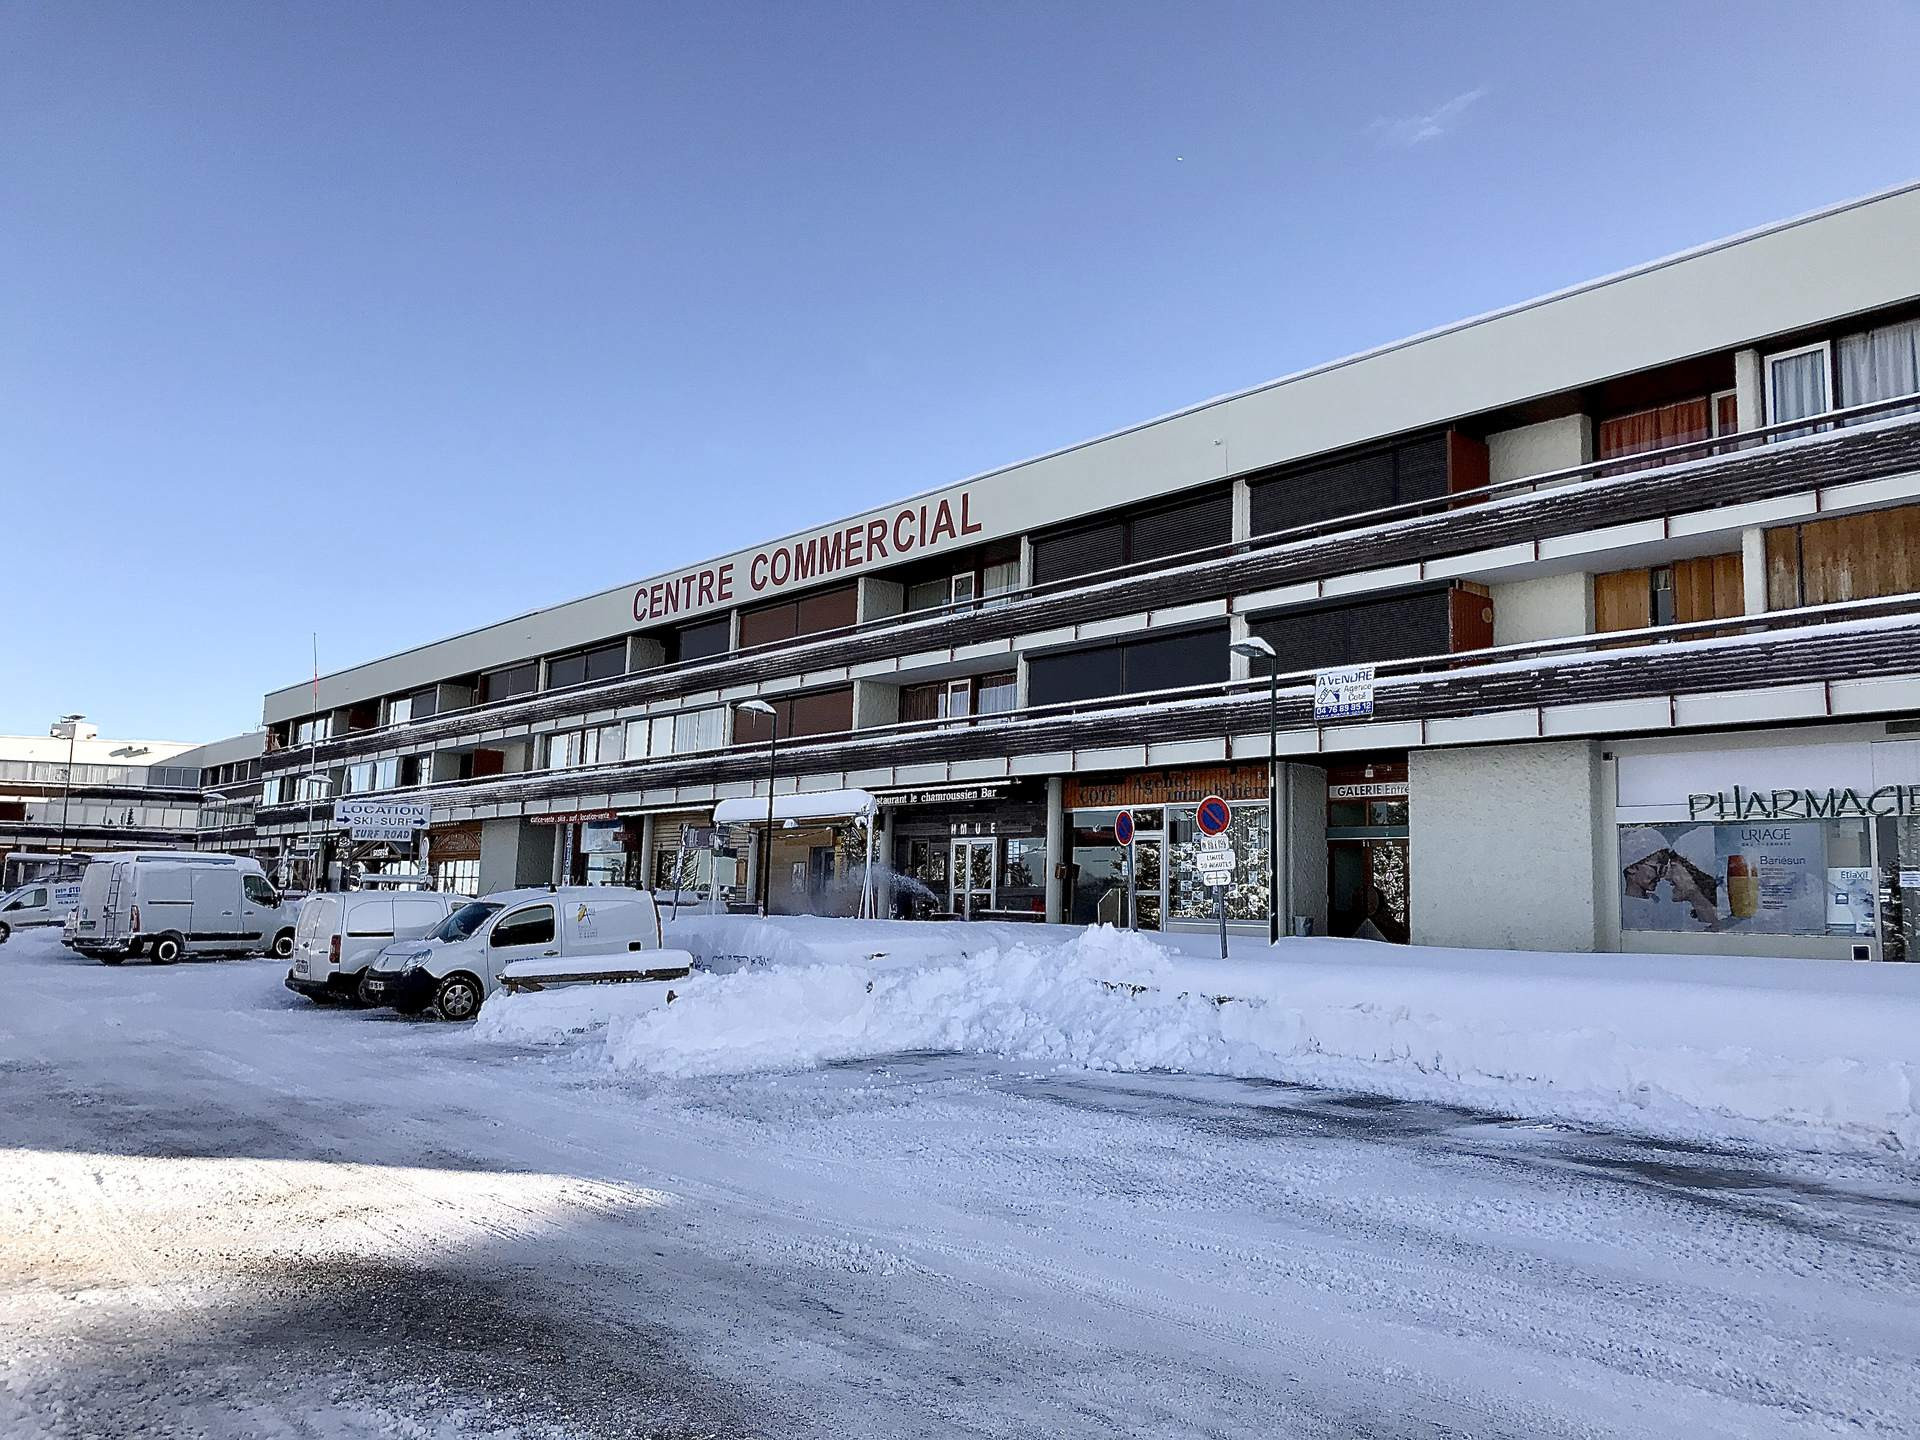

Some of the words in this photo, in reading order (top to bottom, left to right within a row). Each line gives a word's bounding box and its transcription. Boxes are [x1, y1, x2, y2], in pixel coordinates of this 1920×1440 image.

[633, 563, 735, 622] CENTRE
[750, 492, 983, 591] COMMERCIAL
[1328, 670, 1373, 686] VENDRE
[1316, 707, 1327, 715] 04
[1328, 706, 1338, 714] 76
[1362, 701, 1372, 709] 12
[876, 794, 908, 804] staurant
[910, 793, 919, 803] le
[921, 788, 978, 803] chamroussien
[981, 787, 998, 799] Bar
[1337, 784, 1382, 797] GALERIE
[1385, 784, 1410, 795] Entré
[1688, 783, 1920, 821] PHARMACIE
[342, 805, 425, 816] LOCATION
[354, 828, 380, 839] SURF
[384, 828, 410, 839] ROAD
[1741, 828, 1792, 843] URIAGE
[1760, 855, 1806, 865] Bariésun
